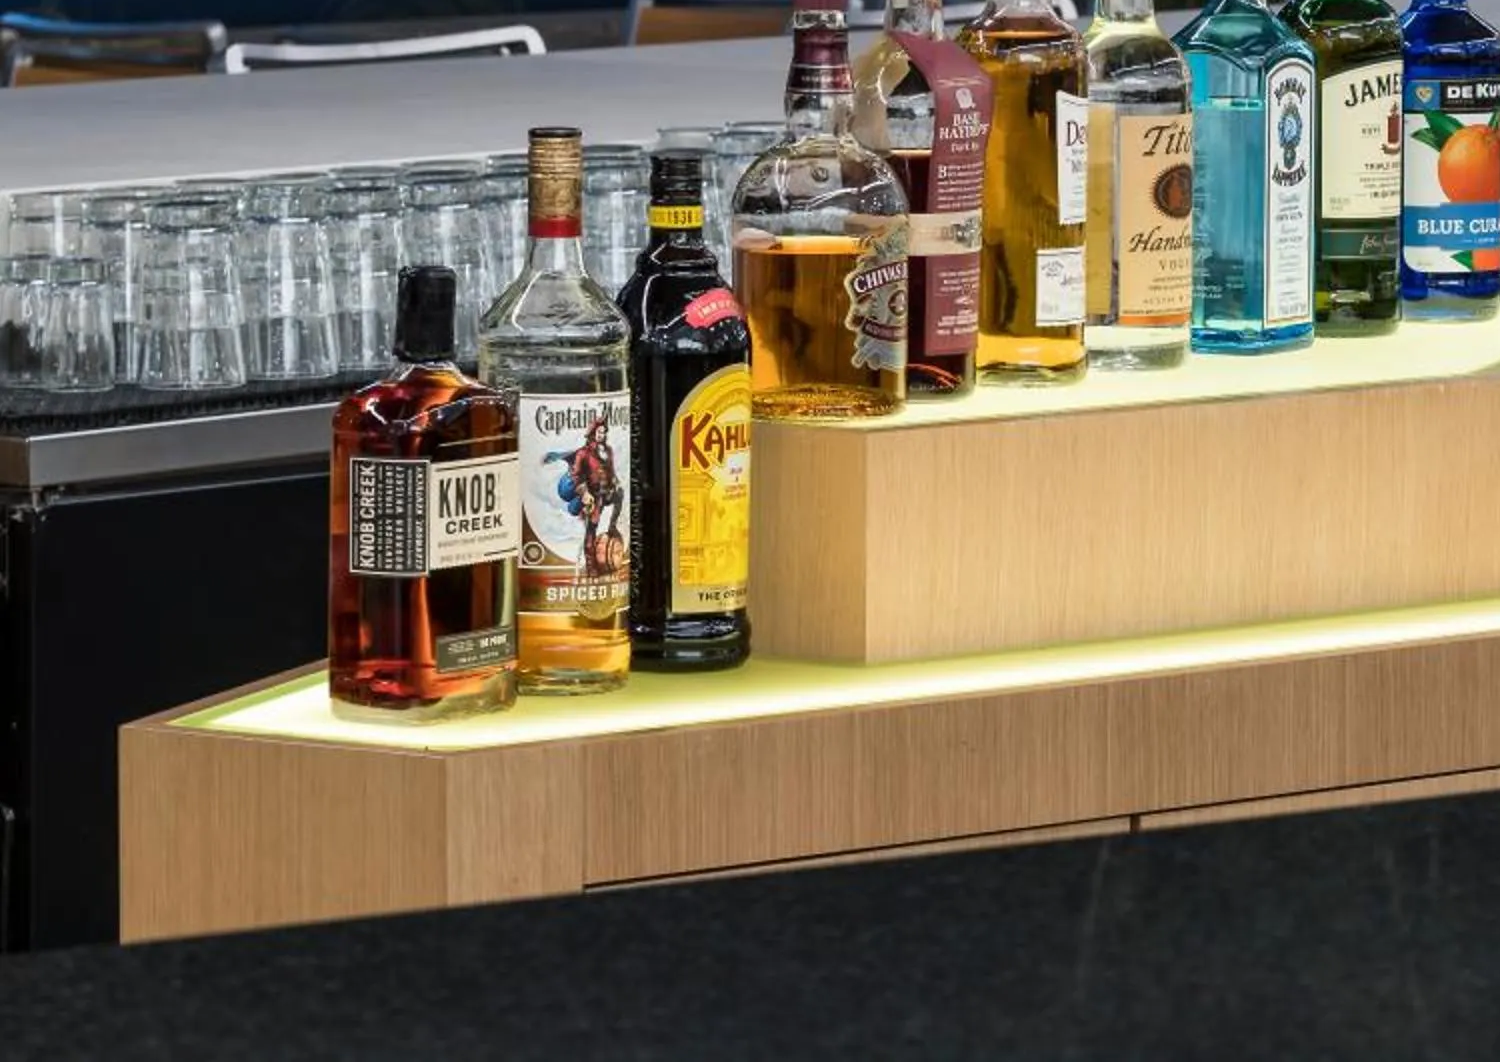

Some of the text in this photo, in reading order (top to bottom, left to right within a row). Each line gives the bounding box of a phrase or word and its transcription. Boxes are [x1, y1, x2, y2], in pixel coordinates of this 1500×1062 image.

[1447, 85, 1473, 99] DE
[1417, 219, 1465, 235] BLUE
[534, 402, 597, 436] Captain
[439, 473, 496, 519] KNOB
[359, 464, 375, 568] KNOB CREEK
[445, 514, 503, 535] CREEK
[546, 587, 607, 602] SPICED
